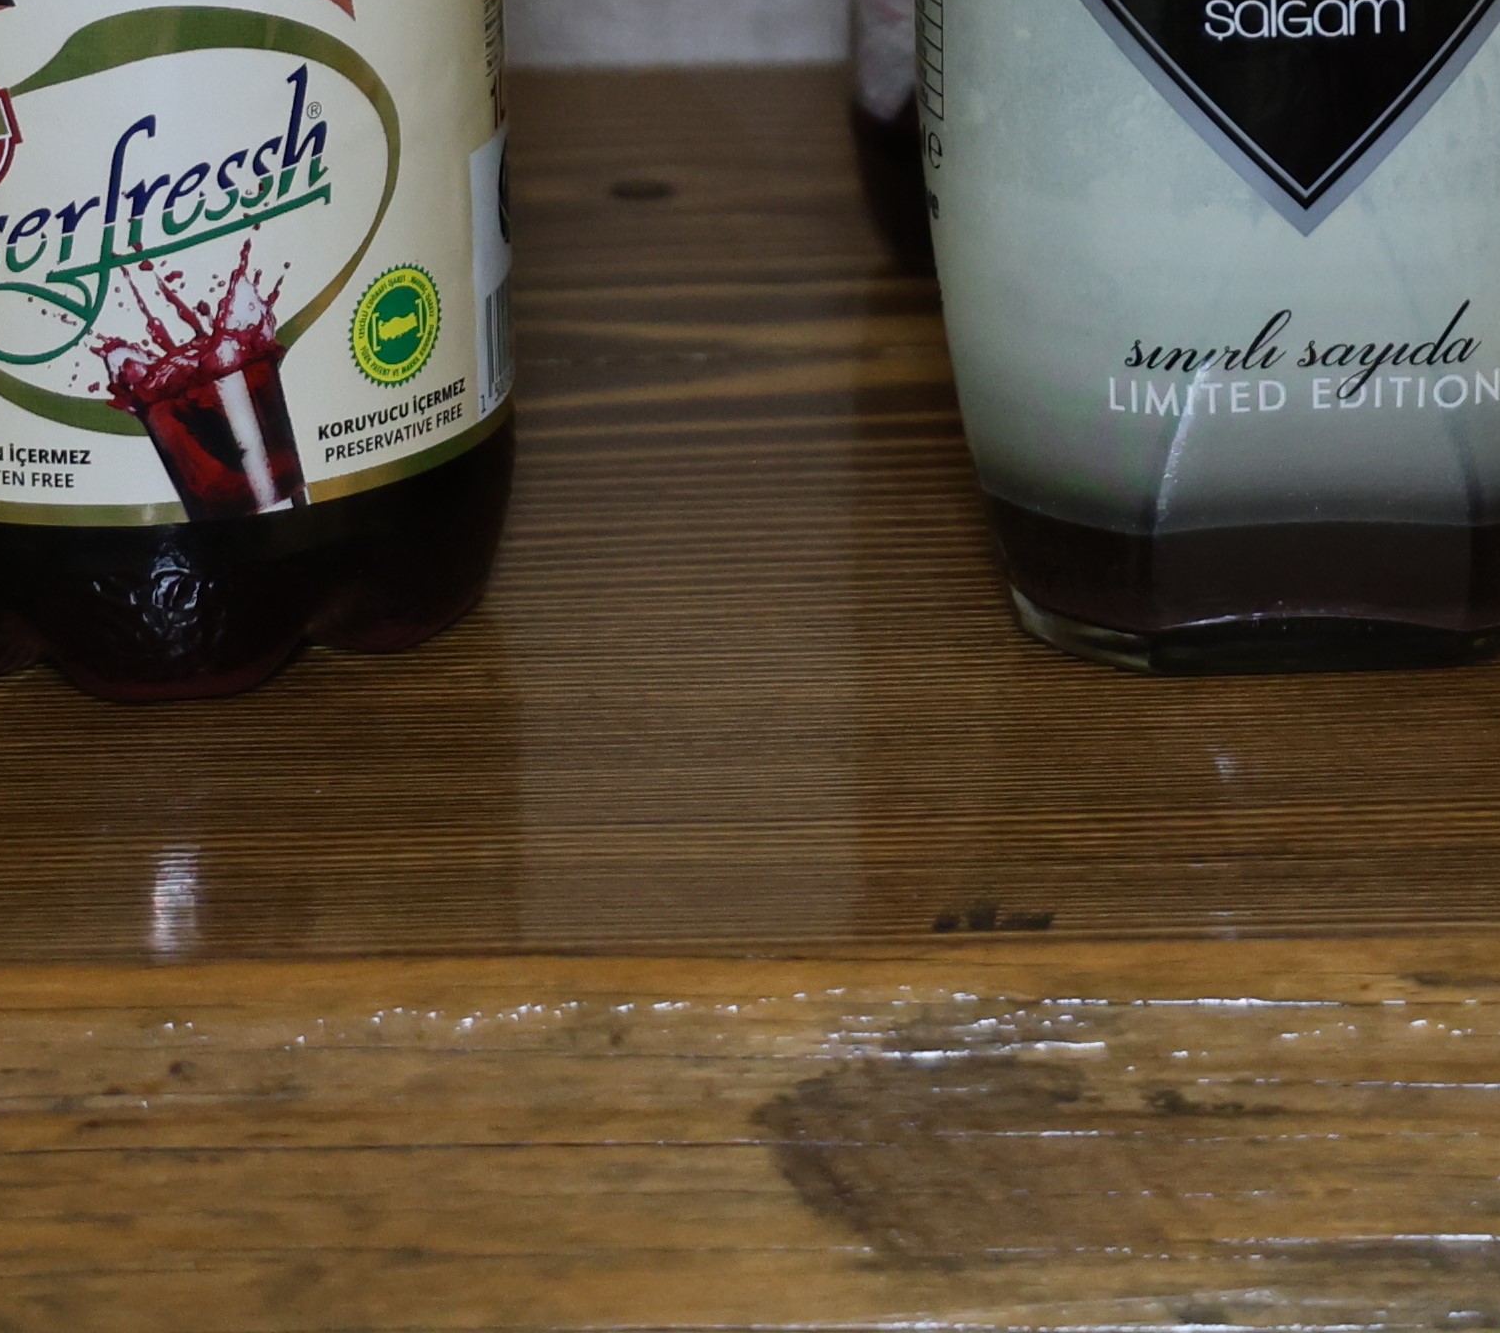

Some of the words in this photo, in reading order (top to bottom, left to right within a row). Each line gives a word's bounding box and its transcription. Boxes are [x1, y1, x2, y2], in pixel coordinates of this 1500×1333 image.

[318, 402, 409, 440] KORUYUCU
[413, 377, 466, 414] İÇERMEZ
[1109, 376, 1287, 418] LIMITED
[1311, 368, 1500, 411] EDITION
[9, 443, 91, 466] İÇERMEZ
[325, 416, 432, 463] PRESERVATIVE
[436, 402, 463, 428] FREE
[31, 472, 75, 488] FREE
